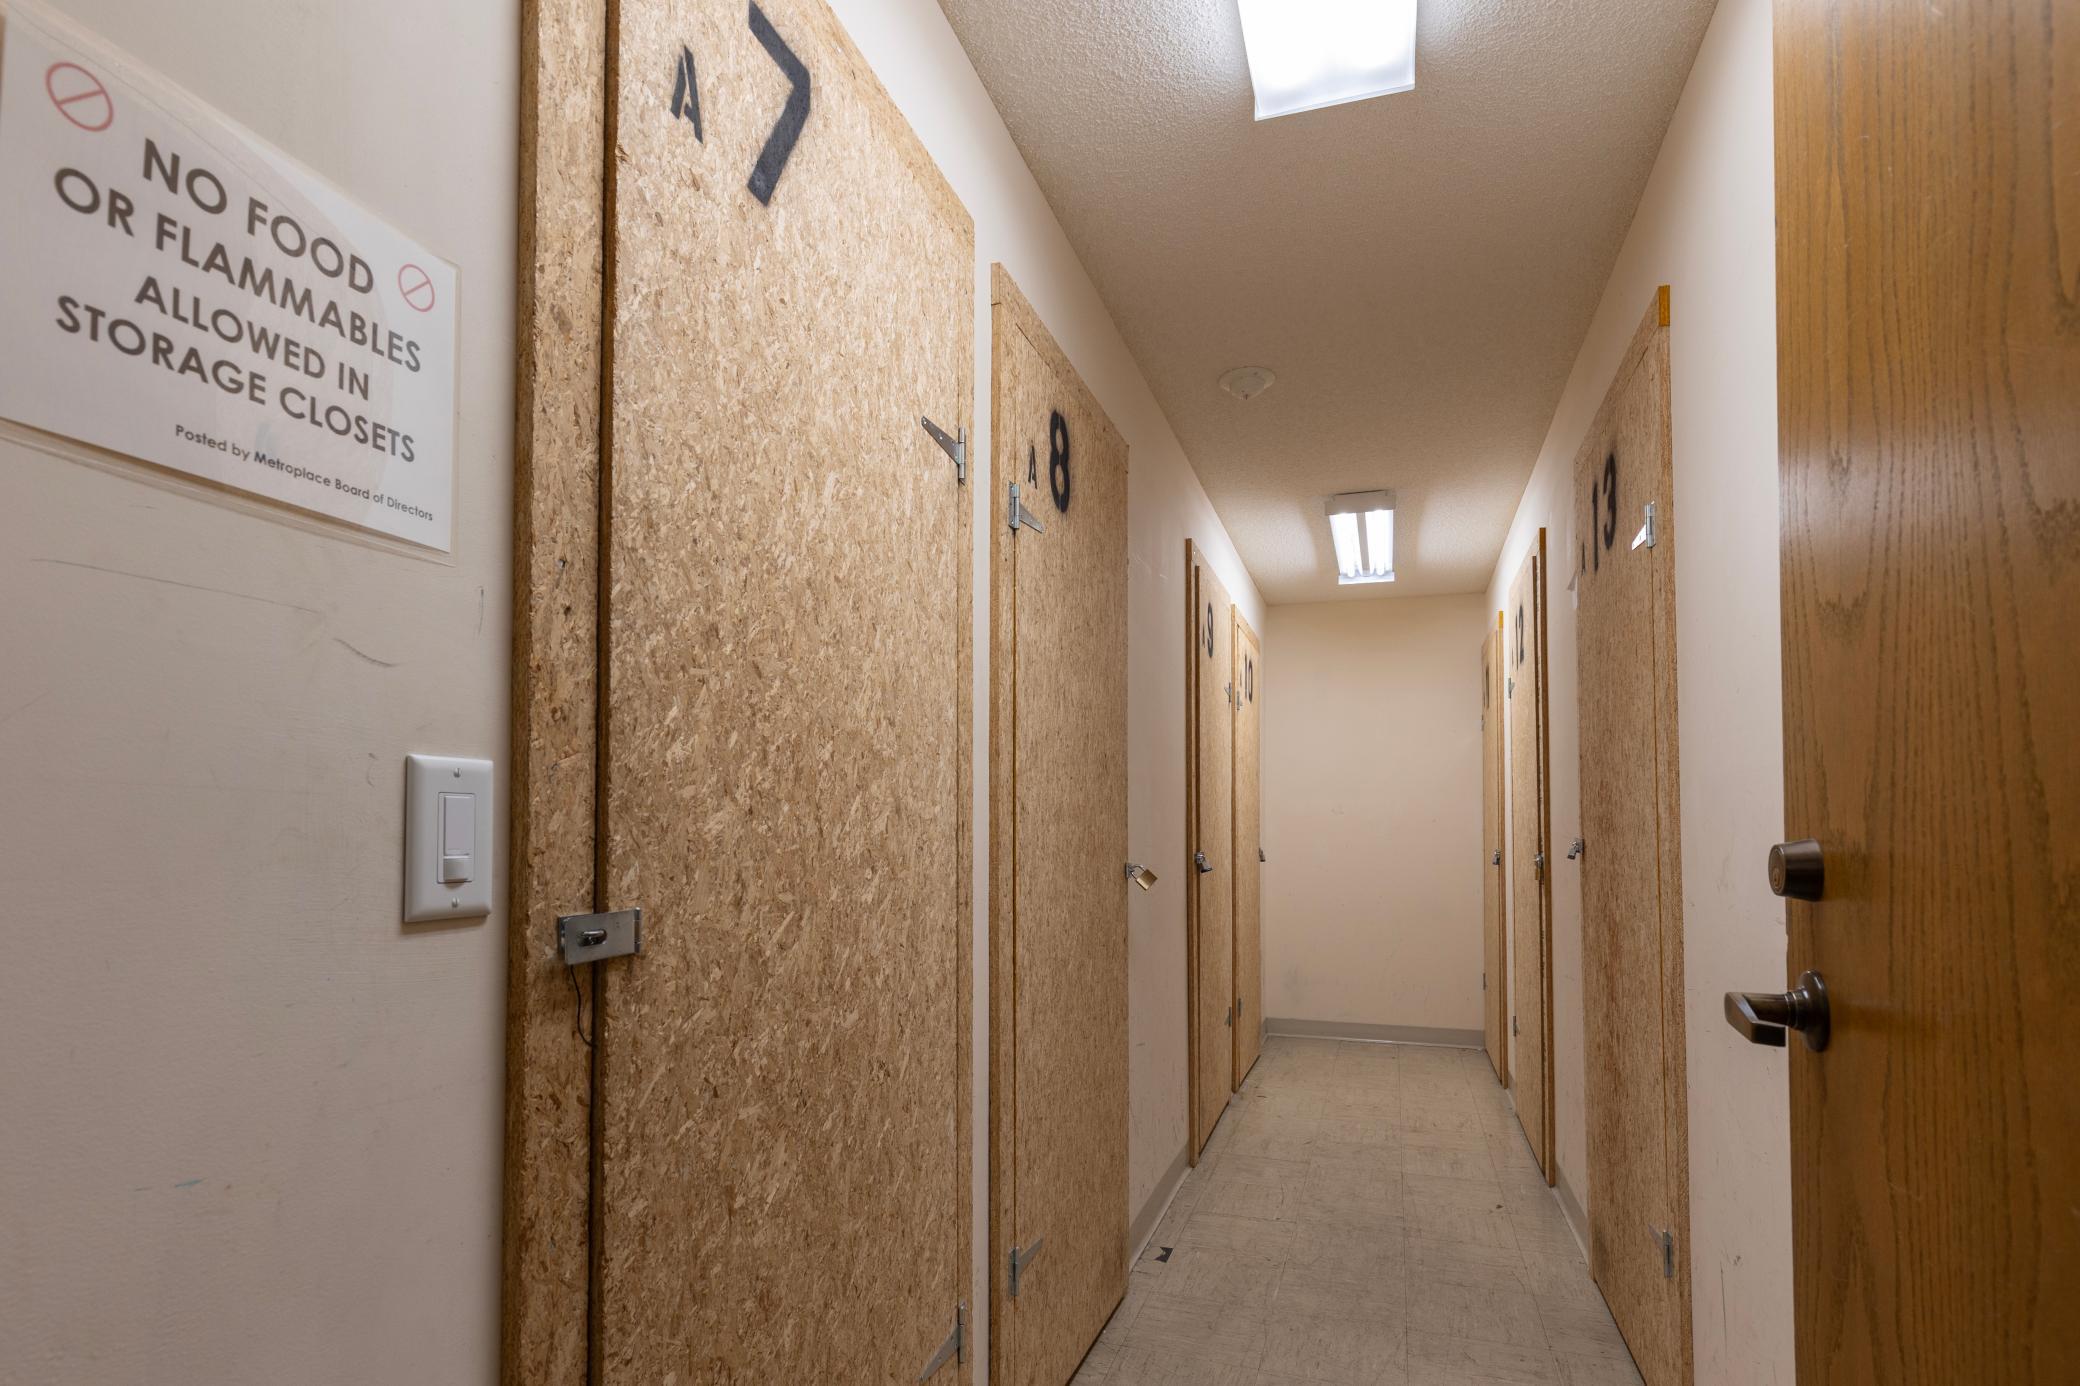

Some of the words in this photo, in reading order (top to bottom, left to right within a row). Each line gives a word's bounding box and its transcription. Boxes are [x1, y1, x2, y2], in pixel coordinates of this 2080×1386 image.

[747, 0, 812, 207] 7
[54, 167, 135, 237] OR
[156, 212, 421, 373] FLAMMABLES
[142, 137, 228, 215] NO
[247, 197, 374, 294] FOOD
[56, 295, 267, 405] STORAGE
[279, 386, 416, 463] CLOSETS
[135, 276, 326, 379] ALLOWED
[338, 362, 370, 401] IN
[175, 424, 227, 453] Posted
[232, 443, 251, 462] by
[254, 451, 331, 487] Metroplace
[335, 478, 370, 500] Board
[373, 492, 385, 504] of
[387, 496, 434, 521] Directors
[1049, 408, 1070, 514] 8
[1592, 452, 1617, 574] 13
[1515, 604, 1525, 671] 12
